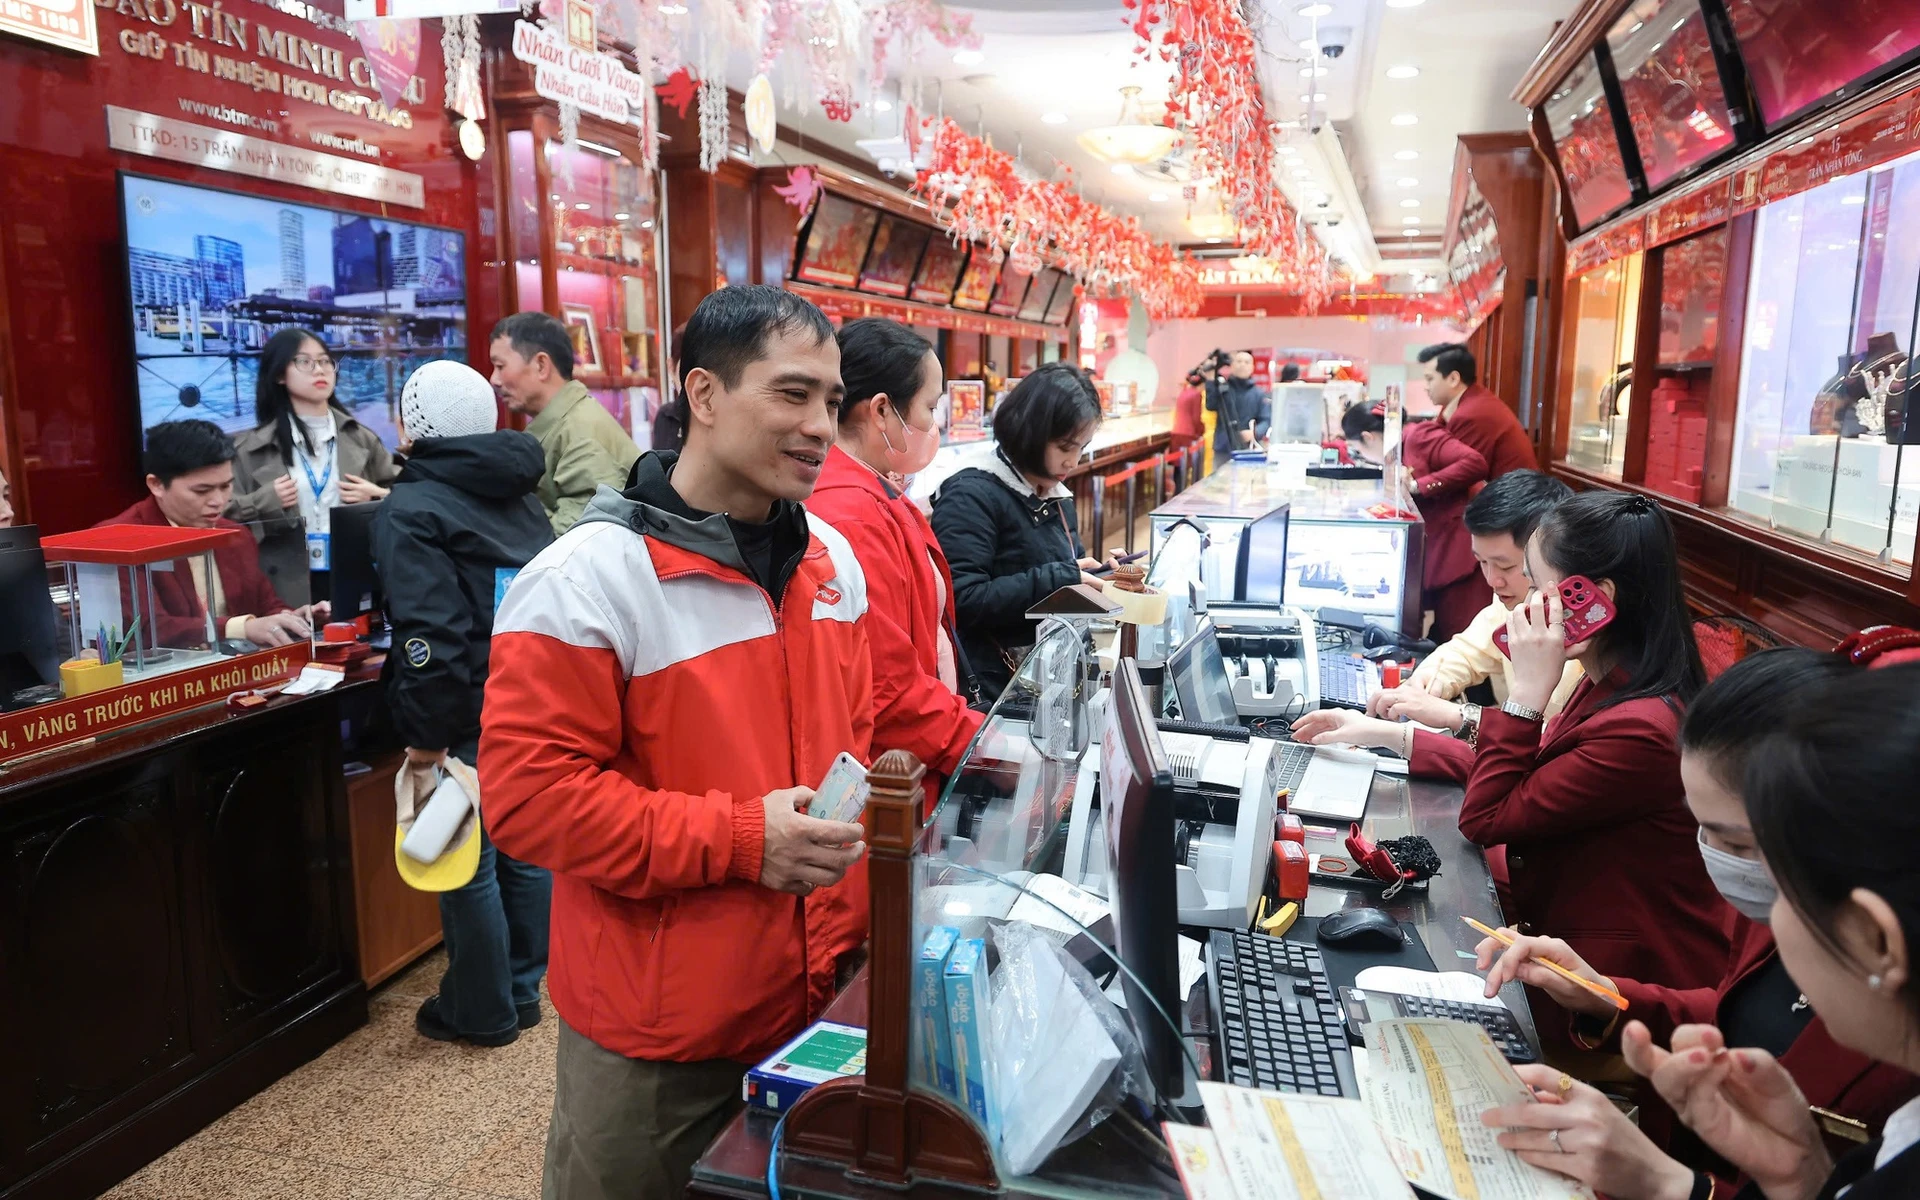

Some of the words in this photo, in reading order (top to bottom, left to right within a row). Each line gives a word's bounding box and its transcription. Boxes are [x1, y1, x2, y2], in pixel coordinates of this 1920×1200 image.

[182, 1, 248, 51] TÍN
[257, 24, 345, 82] MINH
[519, 28, 564, 66] Nhẫn
[120, 29, 167, 60] GIỮ
[172, 41, 209, 73] TÍN
[213, 54, 280, 92] NHIỆN
[283, 74, 328, 106] HƠN
[540, 71, 575, 98] Nhẫn
[178, 97, 278, 133] www.btmc.vn
[129, 123, 177, 148] TTKD:
[183, 135, 199, 151] 15
[1831, 136, 1841, 154] 15
[23, 712, 77, 743] VÀNG
[83, 693, 144, 726] TRƯỚC
[150, 690, 178, 708] KHI
[184, 680, 205, 699] RA
[210, 668, 246, 693] KHỎI
[251, 657, 290, 683] QUẦY
